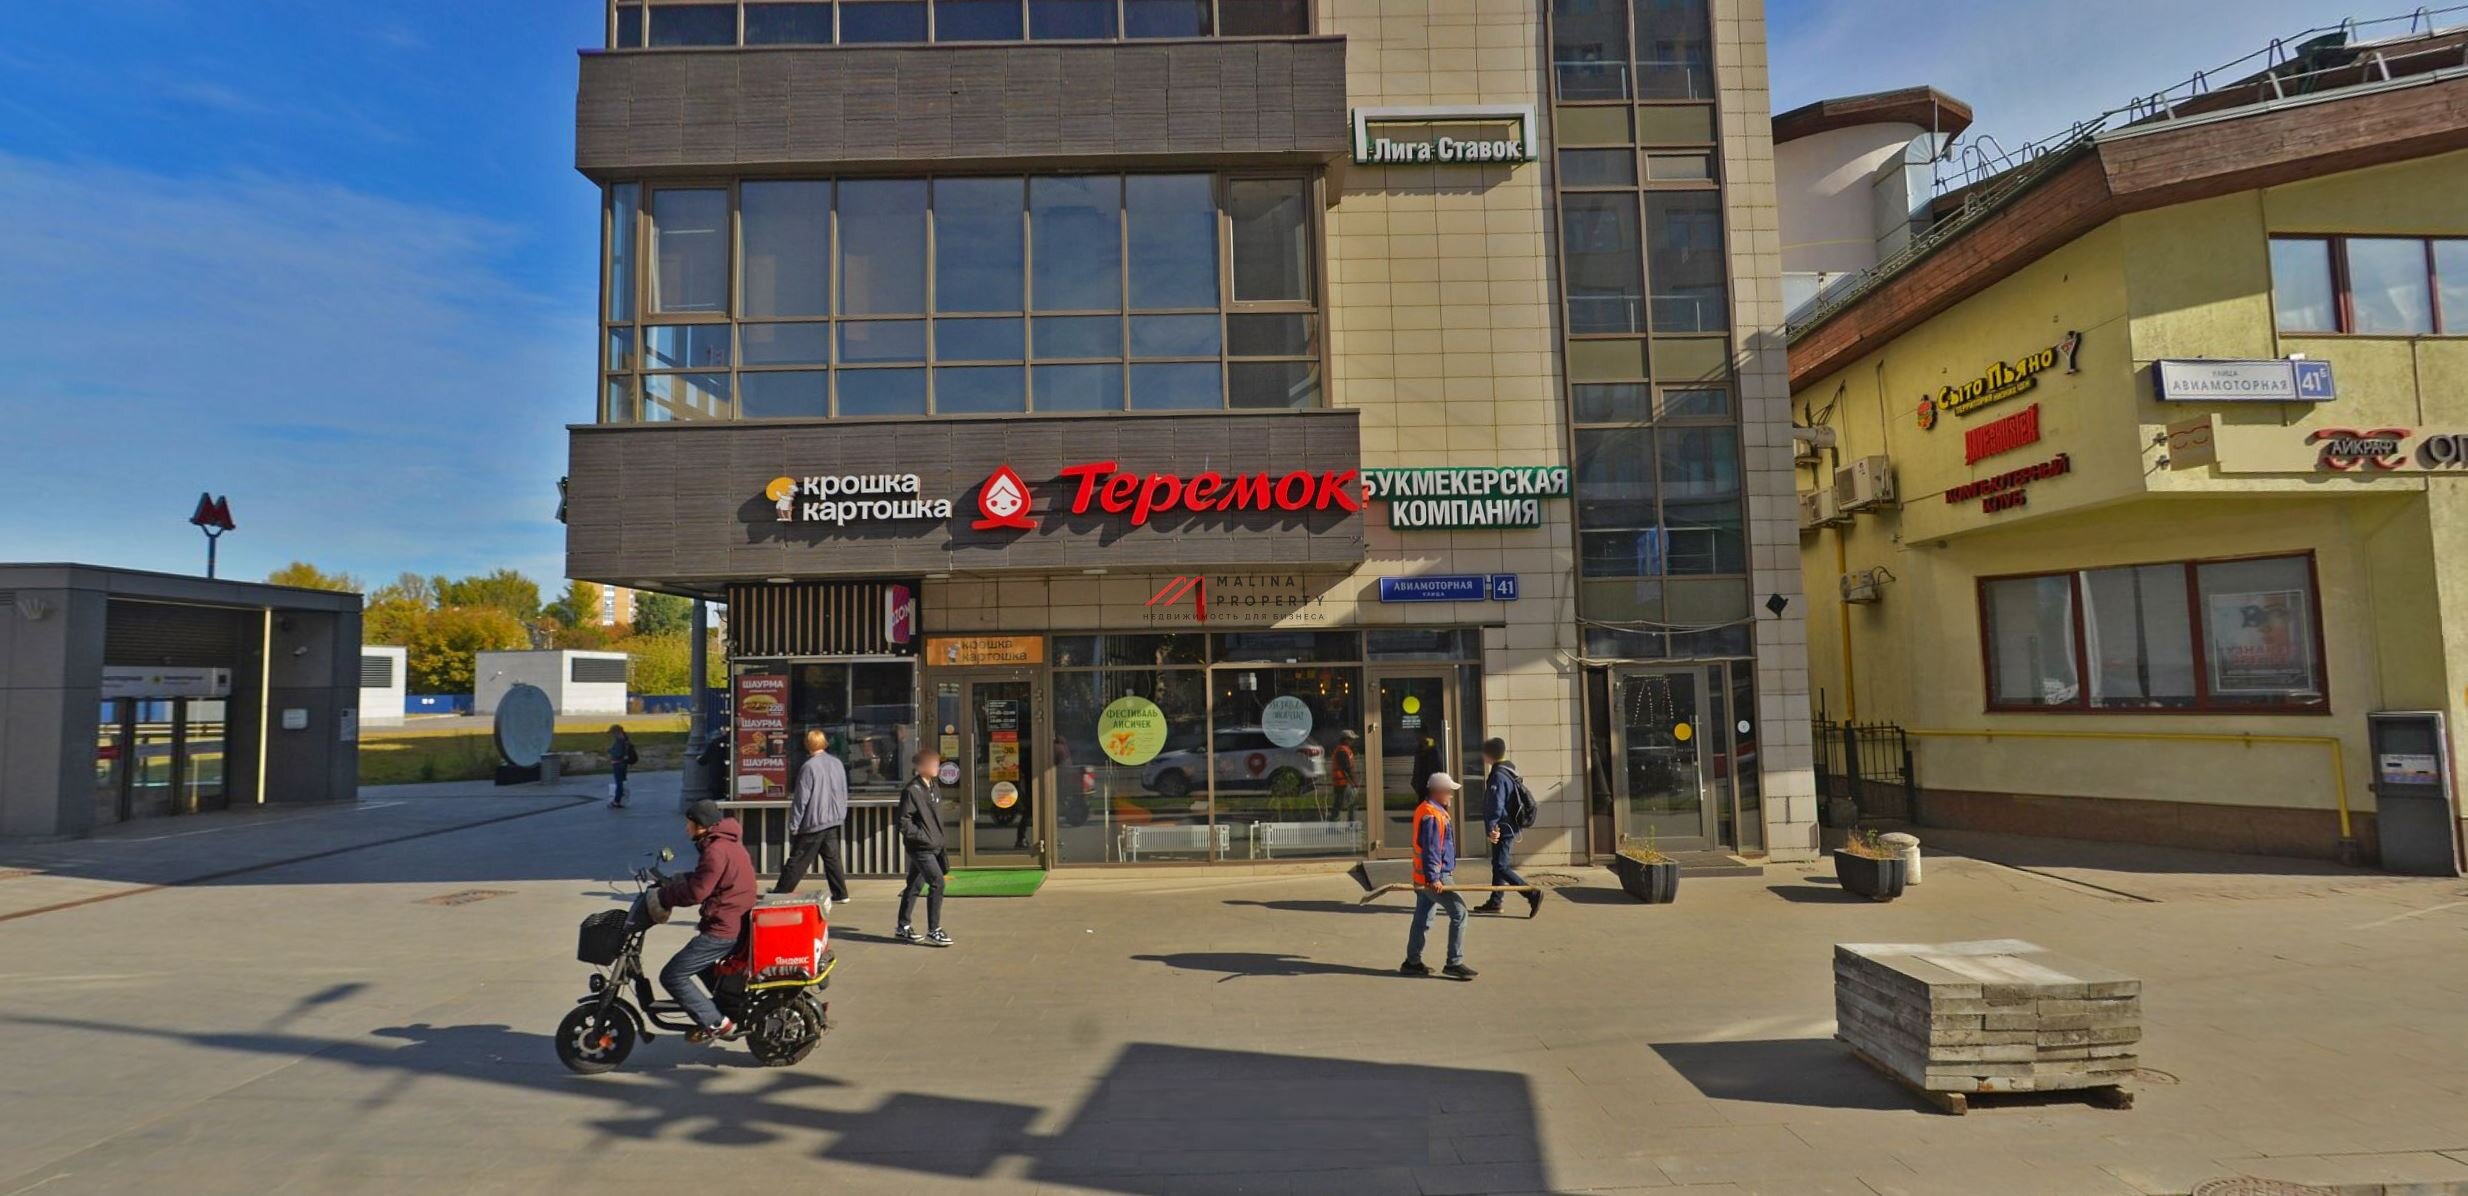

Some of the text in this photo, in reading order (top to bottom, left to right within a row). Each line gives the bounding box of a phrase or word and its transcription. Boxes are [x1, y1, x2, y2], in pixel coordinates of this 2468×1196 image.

[1374, 136, 1521, 163] Лига Ставок
[1937, 348, 2054, 411] Сыто Пьяно
[2173, 379, 2288, 391] АВИАМОТОРНАЯ
[803, 474, 920, 500] крошка
[1361, 468, 1569, 497] БУКМЕКЕРСКАЯ
[1061, 460, 1360, 526] Теремок
[803, 498, 953, 527] картошка
[1393, 499, 1539, 527] КОМПАНИЯ
[1393, 580, 1514, 595] АВИАМОТОРНАЯ 41
[961, 640, 1013, 653] крошка
[961, 651, 1028, 664] картошка
[742, 679, 784, 689] ШАУРМА
[1106, 709, 1159, 719] ФЕСТИВАЛЬ
[742, 719, 783, 728] ШАУРМА
[743, 758, 784, 767] ШАУРМА
[775, 956, 810, 967] Яндекс
